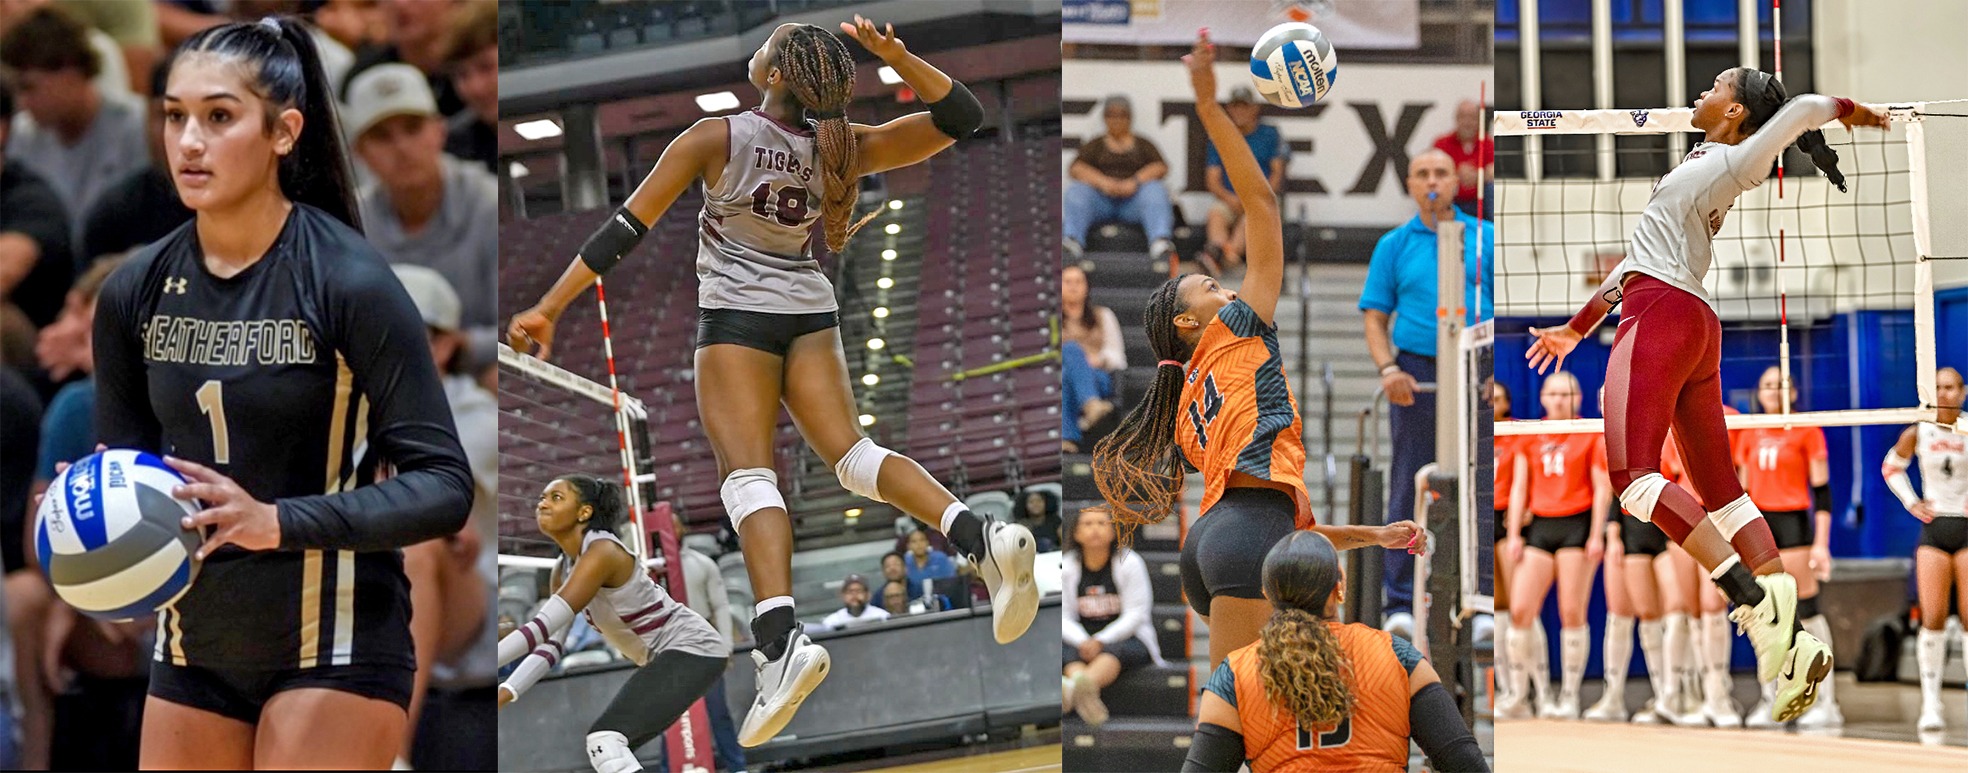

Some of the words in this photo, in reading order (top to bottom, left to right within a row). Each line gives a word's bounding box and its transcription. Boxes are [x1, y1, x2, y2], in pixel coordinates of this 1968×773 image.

[1288, 60, 1313, 97] NCAA
[1303, 49, 1325, 93] molten
[1520, 111, 1562, 119] GEORGIA
[1527, 119, 1556, 127] STATE
[1161, 100, 1494, 196] TEX
[750, 182, 809, 229] 18
[195, 380, 230, 464] 1
[1187, 370, 1224, 450] 14
[1758, 446, 1778, 471] 11
